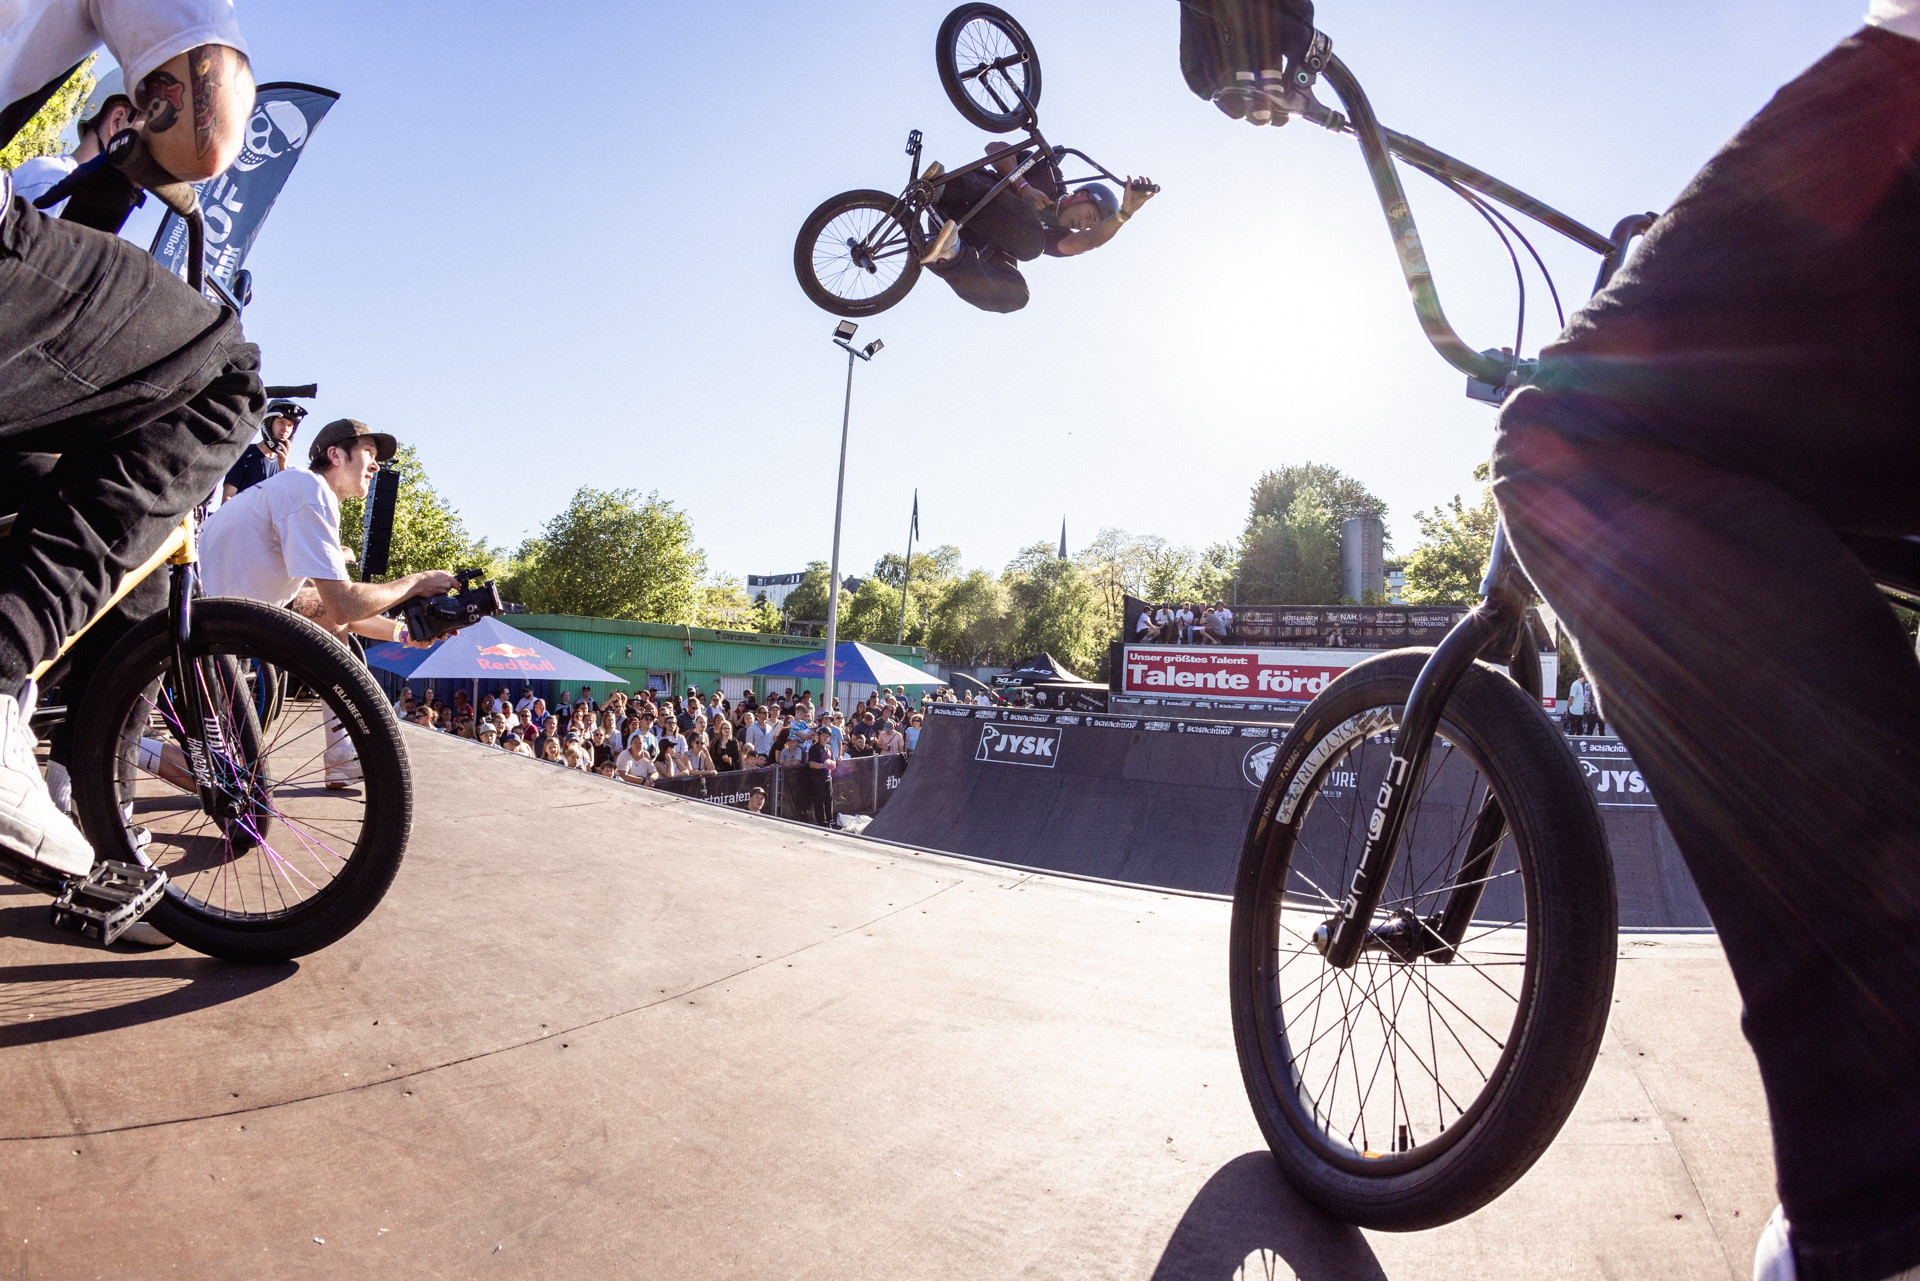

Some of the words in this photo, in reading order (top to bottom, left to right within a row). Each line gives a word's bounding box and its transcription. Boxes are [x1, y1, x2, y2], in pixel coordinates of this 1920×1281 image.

[1008, 158, 1036, 183] VOLUME
[781, 637, 810, 647] Ökostrom
[476, 658, 519, 671] Red
[519, 660, 556, 671] Bull
[1129, 652, 1162, 662] Unser
[1163, 654, 1208, 664] größtes
[1210, 656, 1248, 665] Talent:
[1128, 664, 1250, 690] Talente
[1257, 669, 1329, 693] förd
[332, 683, 362, 719] KILLABEE
[994, 734, 1055, 756] JYSK
[1293, 721, 1355, 794] SKYLARK
[1597, 770, 1650, 793] JYS
